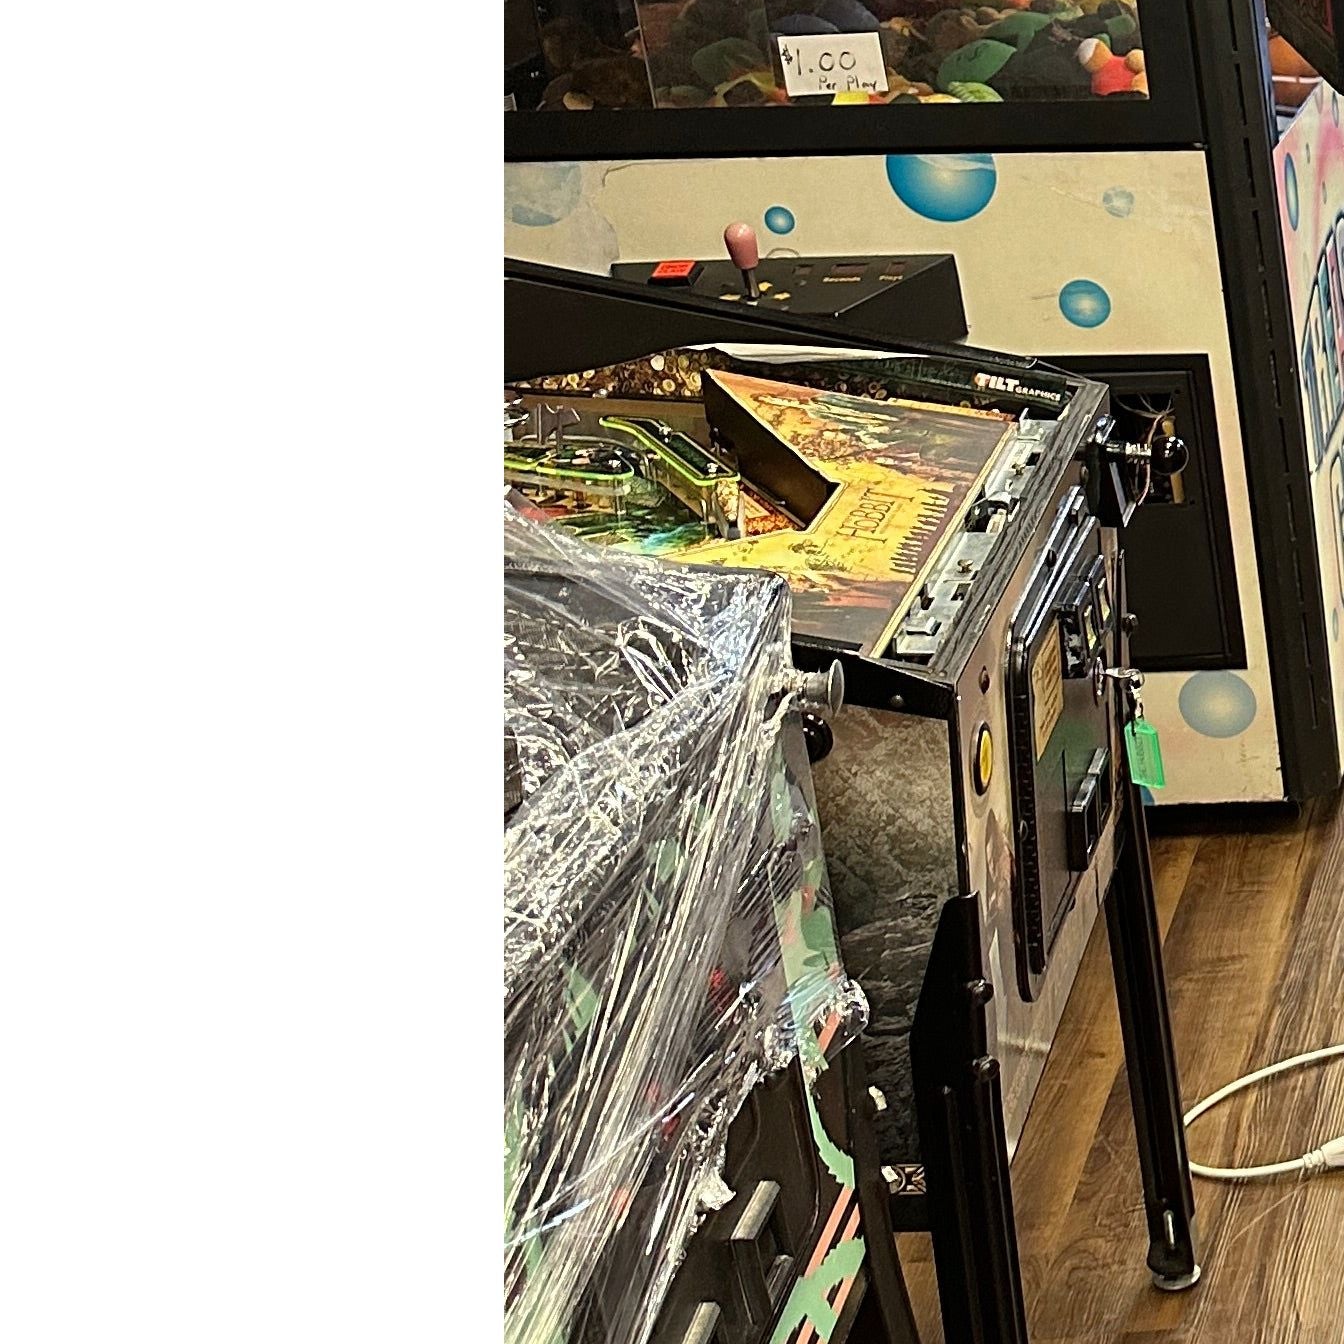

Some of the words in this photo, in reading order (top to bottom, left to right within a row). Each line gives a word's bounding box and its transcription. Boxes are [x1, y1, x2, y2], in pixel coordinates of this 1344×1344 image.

[782, 43, 857, 76] $1.00
[819, 75, 836, 90] Per
[846, 74, 877, 92] Play
[974, 372, 1021, 393] TILT
[1015, 385, 1062, 403] GRAPHICS
[836, 487, 916, 545] HOBBIT
